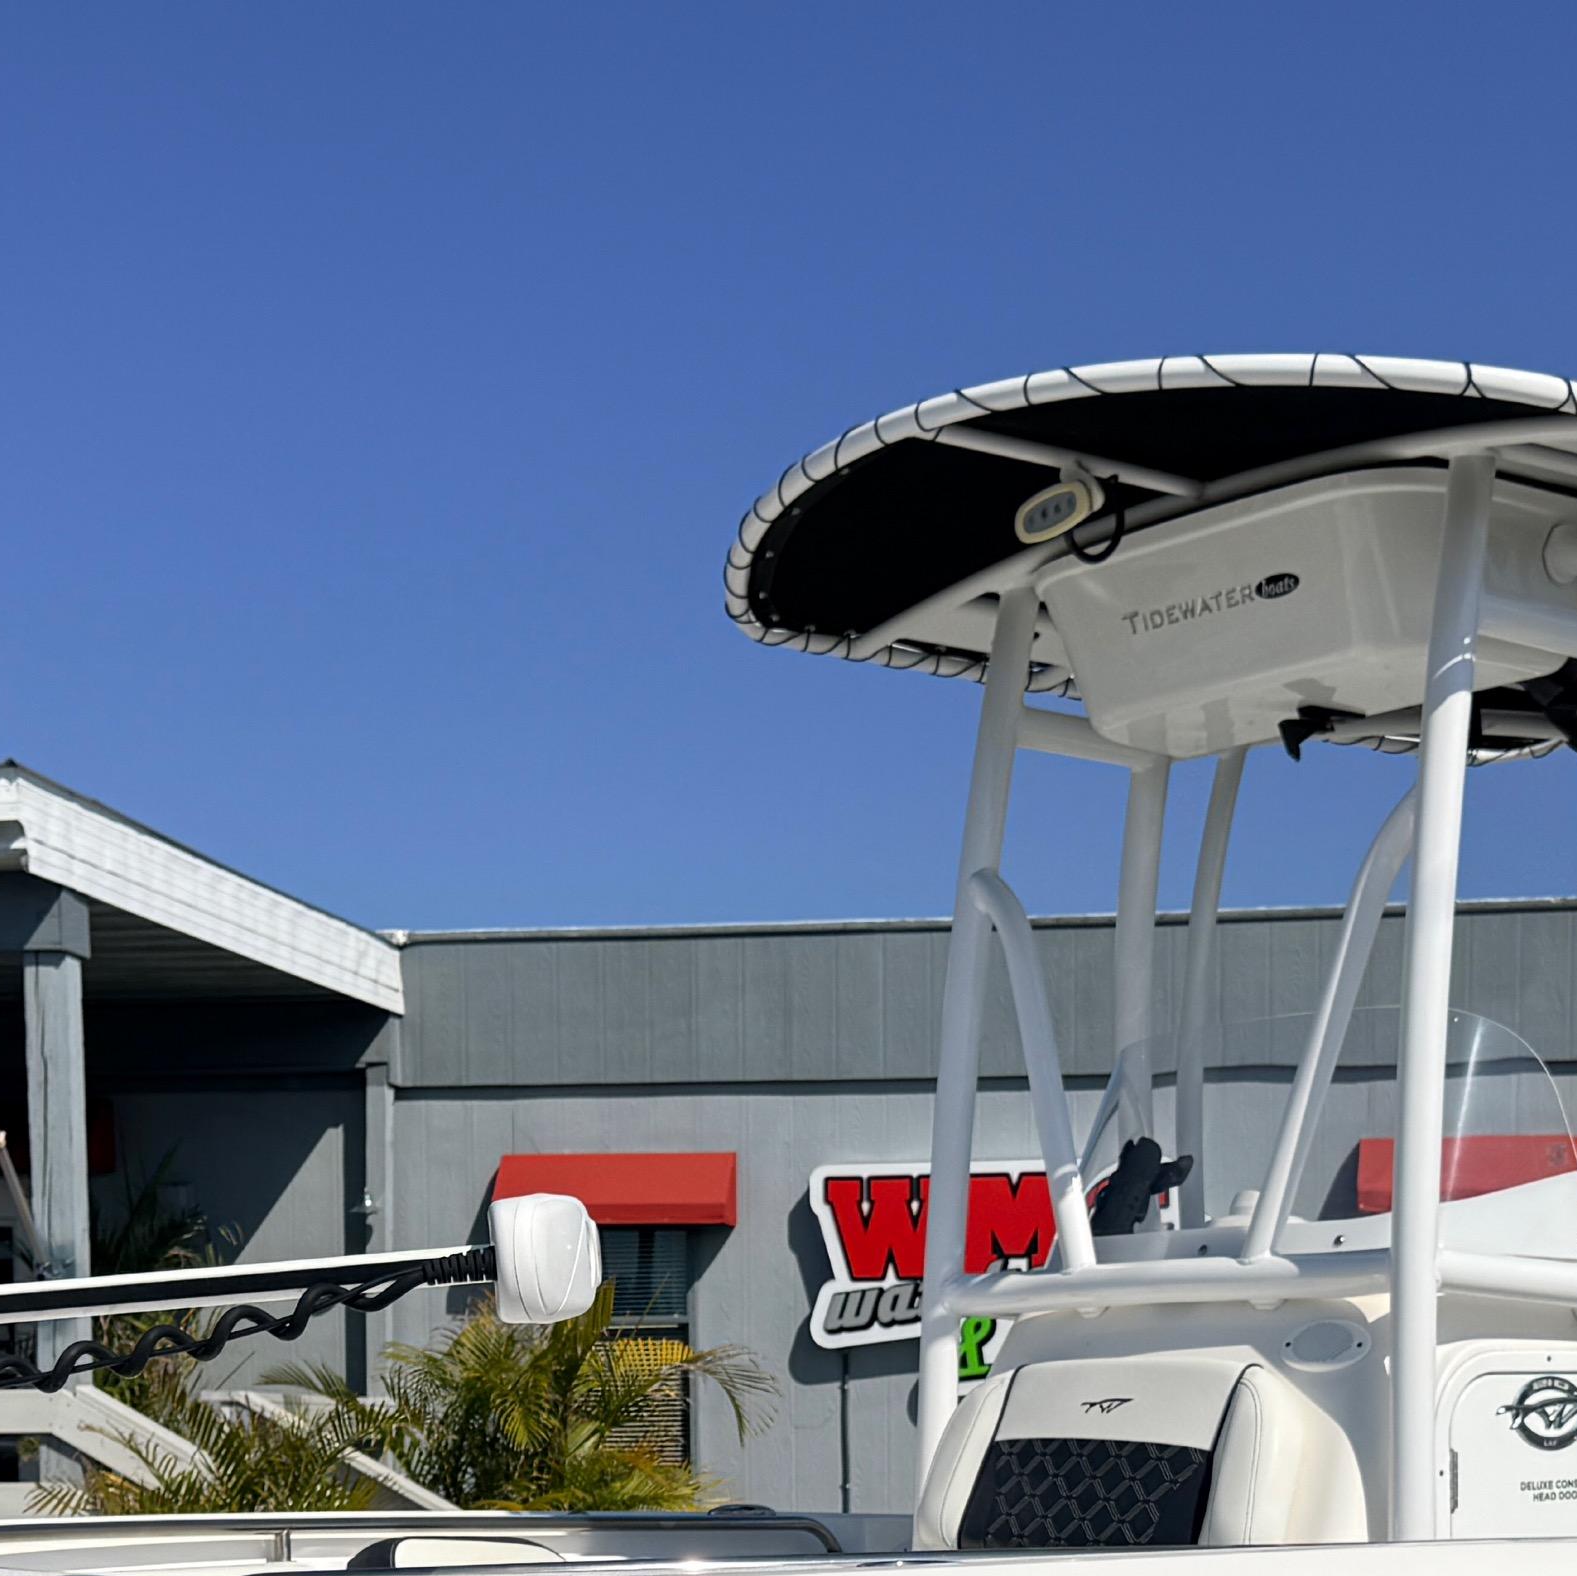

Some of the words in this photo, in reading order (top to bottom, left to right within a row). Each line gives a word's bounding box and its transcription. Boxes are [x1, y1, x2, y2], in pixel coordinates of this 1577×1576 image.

[1121, 584, 1255, 635] TIDEWATER
[1260, 574, 1296, 599] boats
[1520, 1480, 1553, 1491] DELUXE
[1533, 1491, 1557, 1502] HEAD
